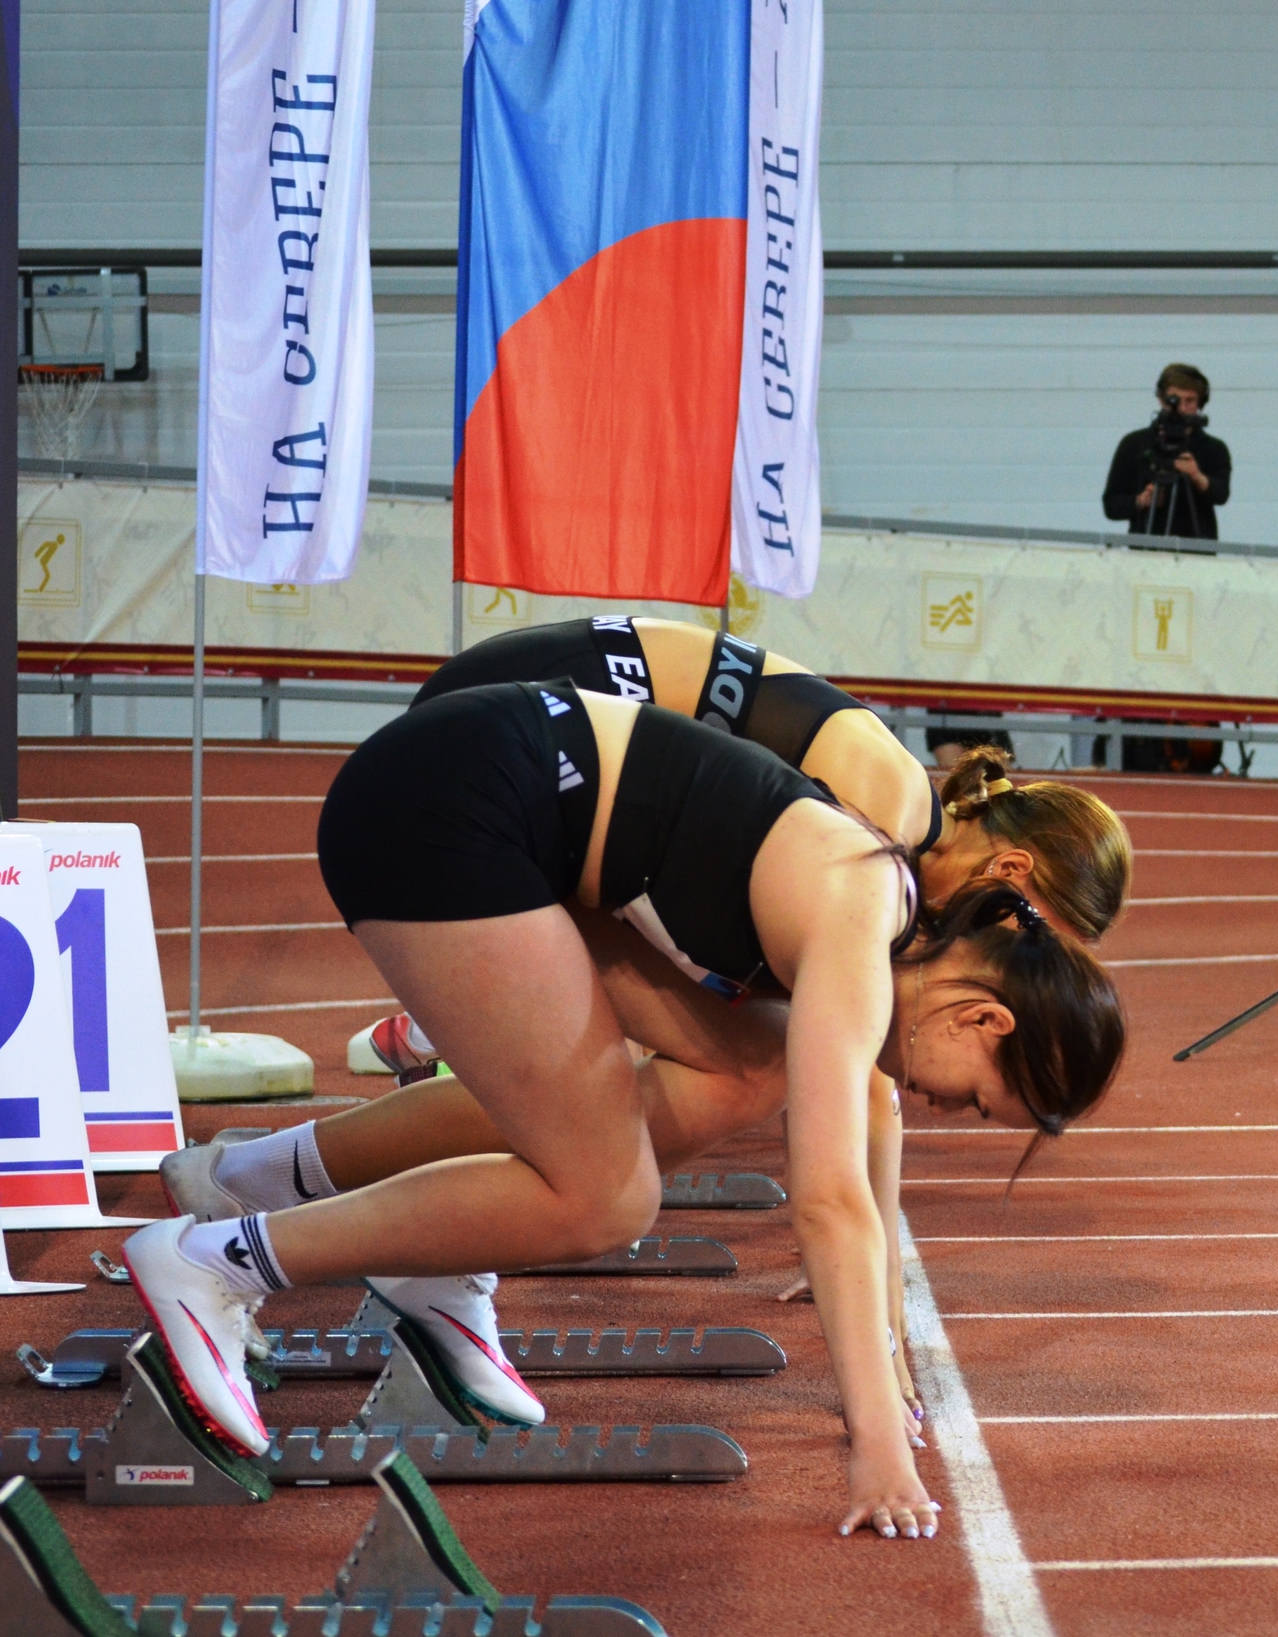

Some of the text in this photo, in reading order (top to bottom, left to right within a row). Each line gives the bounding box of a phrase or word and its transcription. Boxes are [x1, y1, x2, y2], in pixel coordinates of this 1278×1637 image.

[48, 850, 121, 872] polanik
[55, 888, 110, 1092] 1
[138, 1468, 188, 1482] polanik
